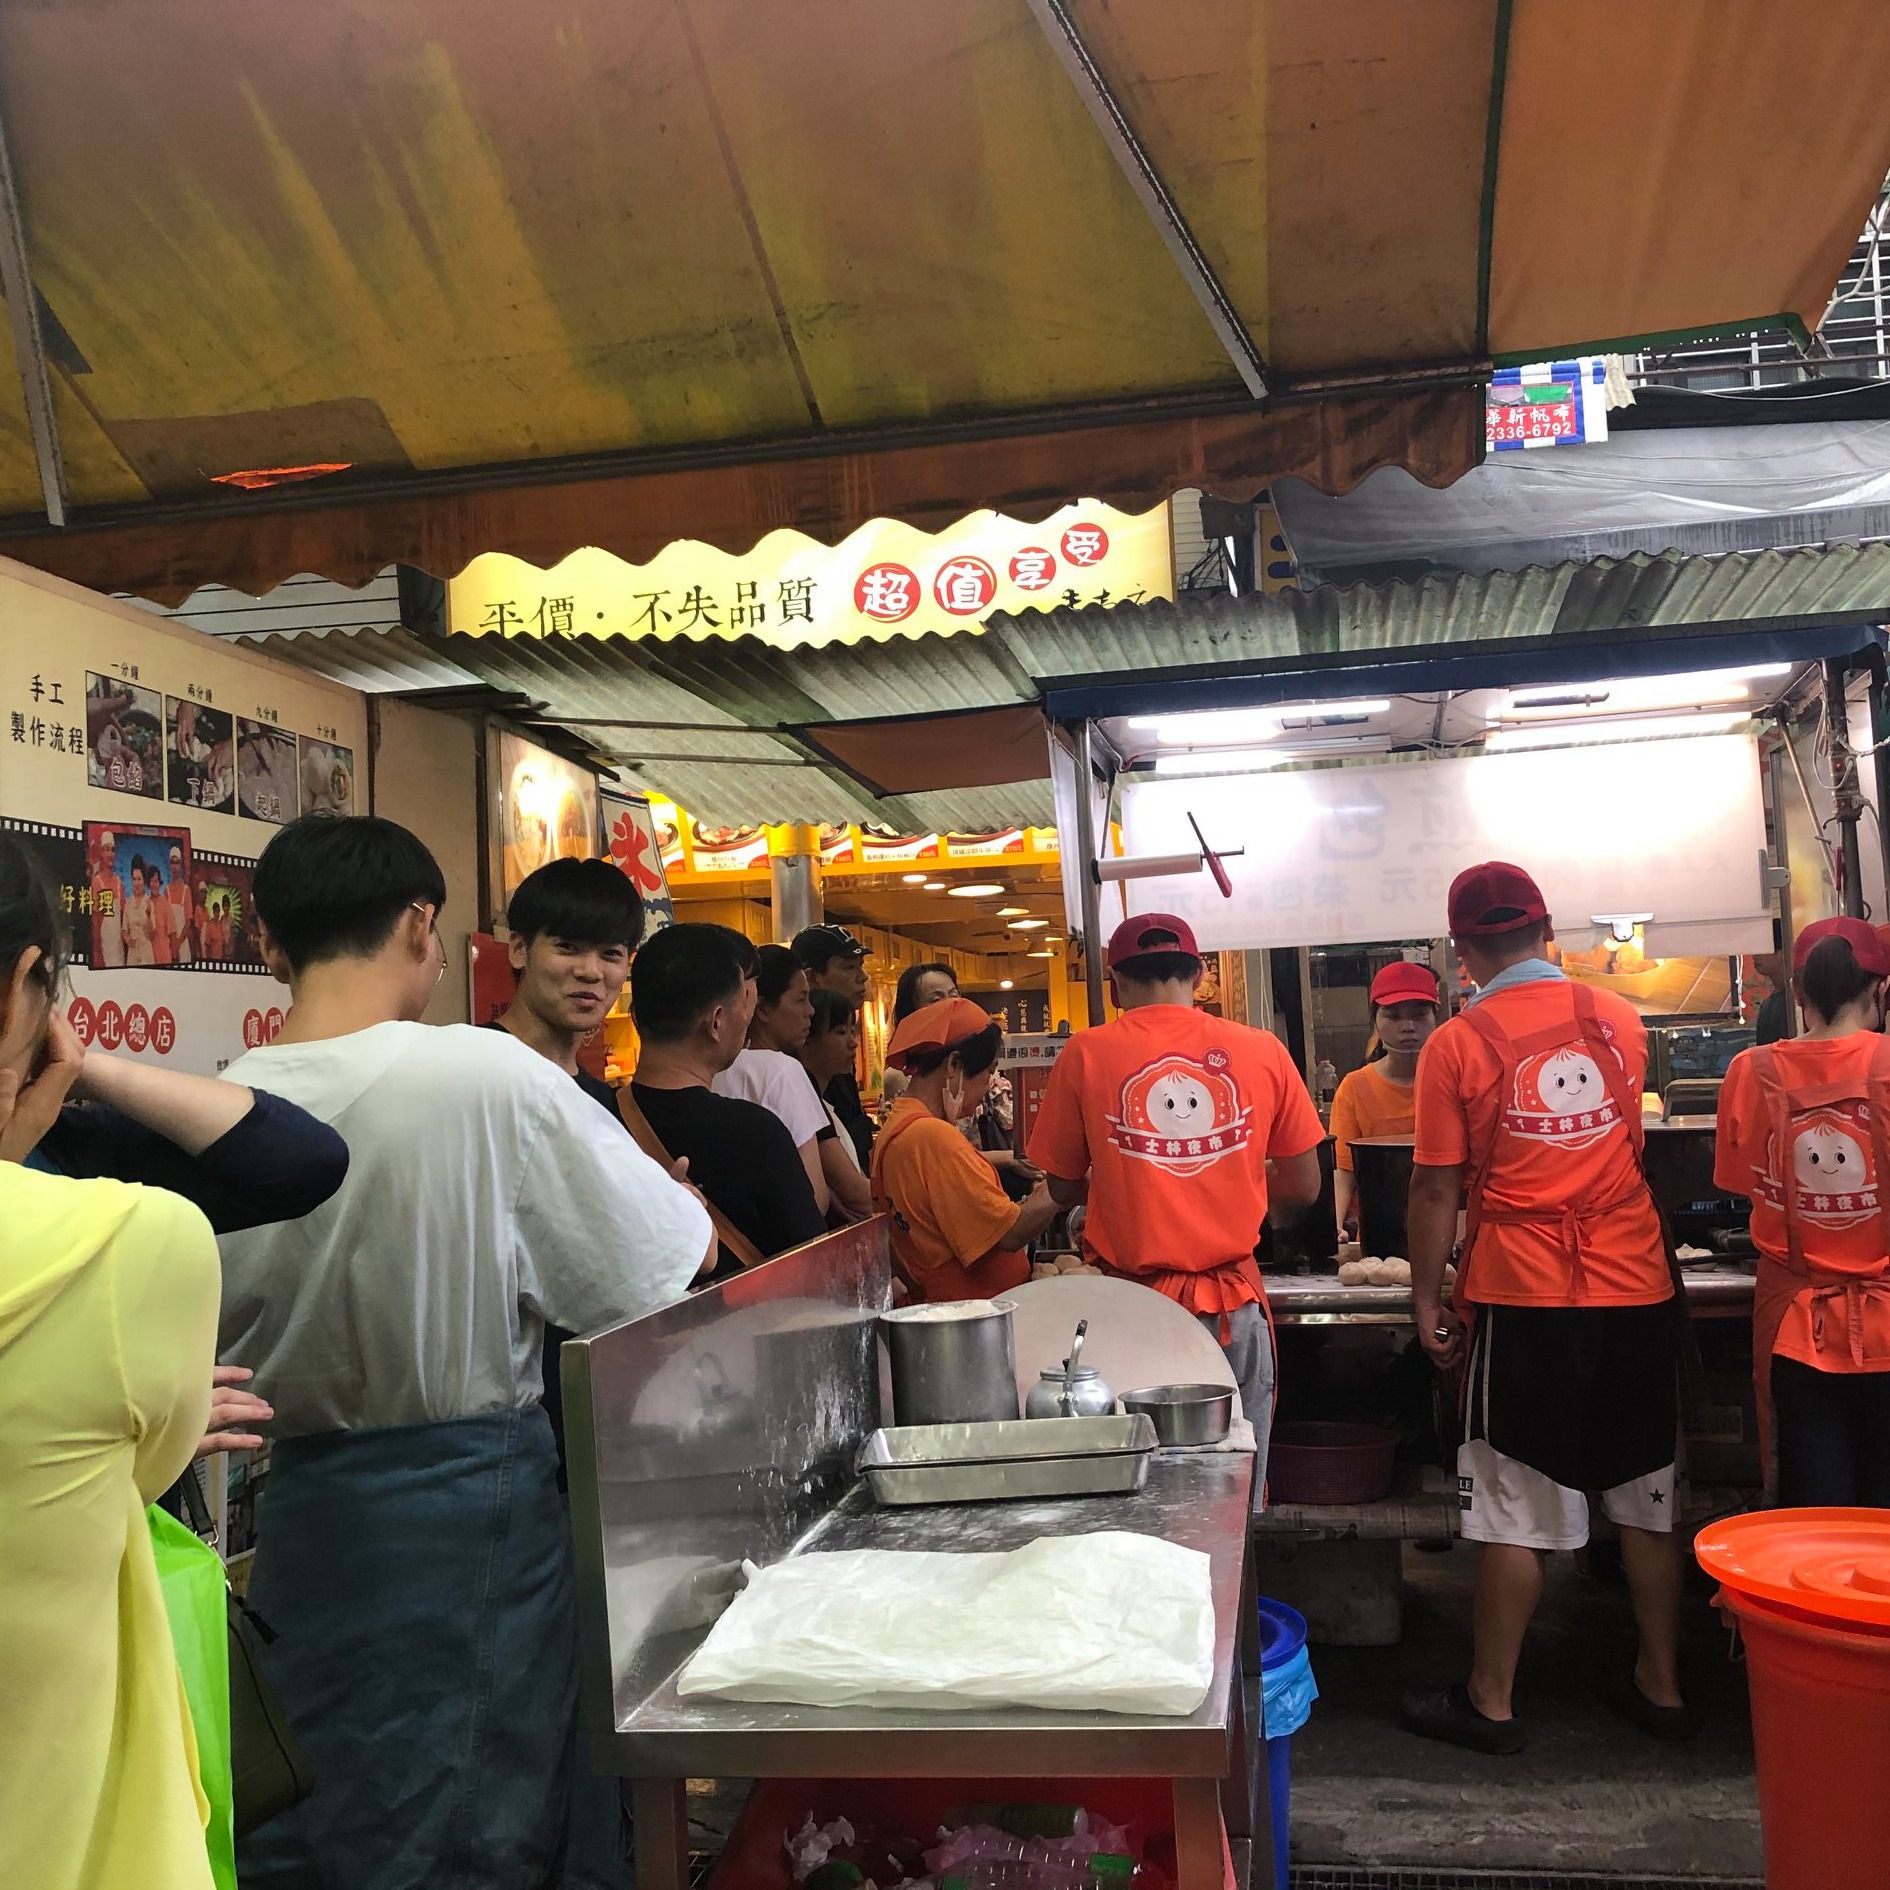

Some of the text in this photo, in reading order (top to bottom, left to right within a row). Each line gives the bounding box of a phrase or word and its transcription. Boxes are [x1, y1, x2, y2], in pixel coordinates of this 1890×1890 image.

[1486, 421, 1572, 441] 2336-6792
[30, 674, 64, 704] 手工
[11, 711, 84, 755] 製作流程
[72, 1004, 172, 1048] 台北總店
